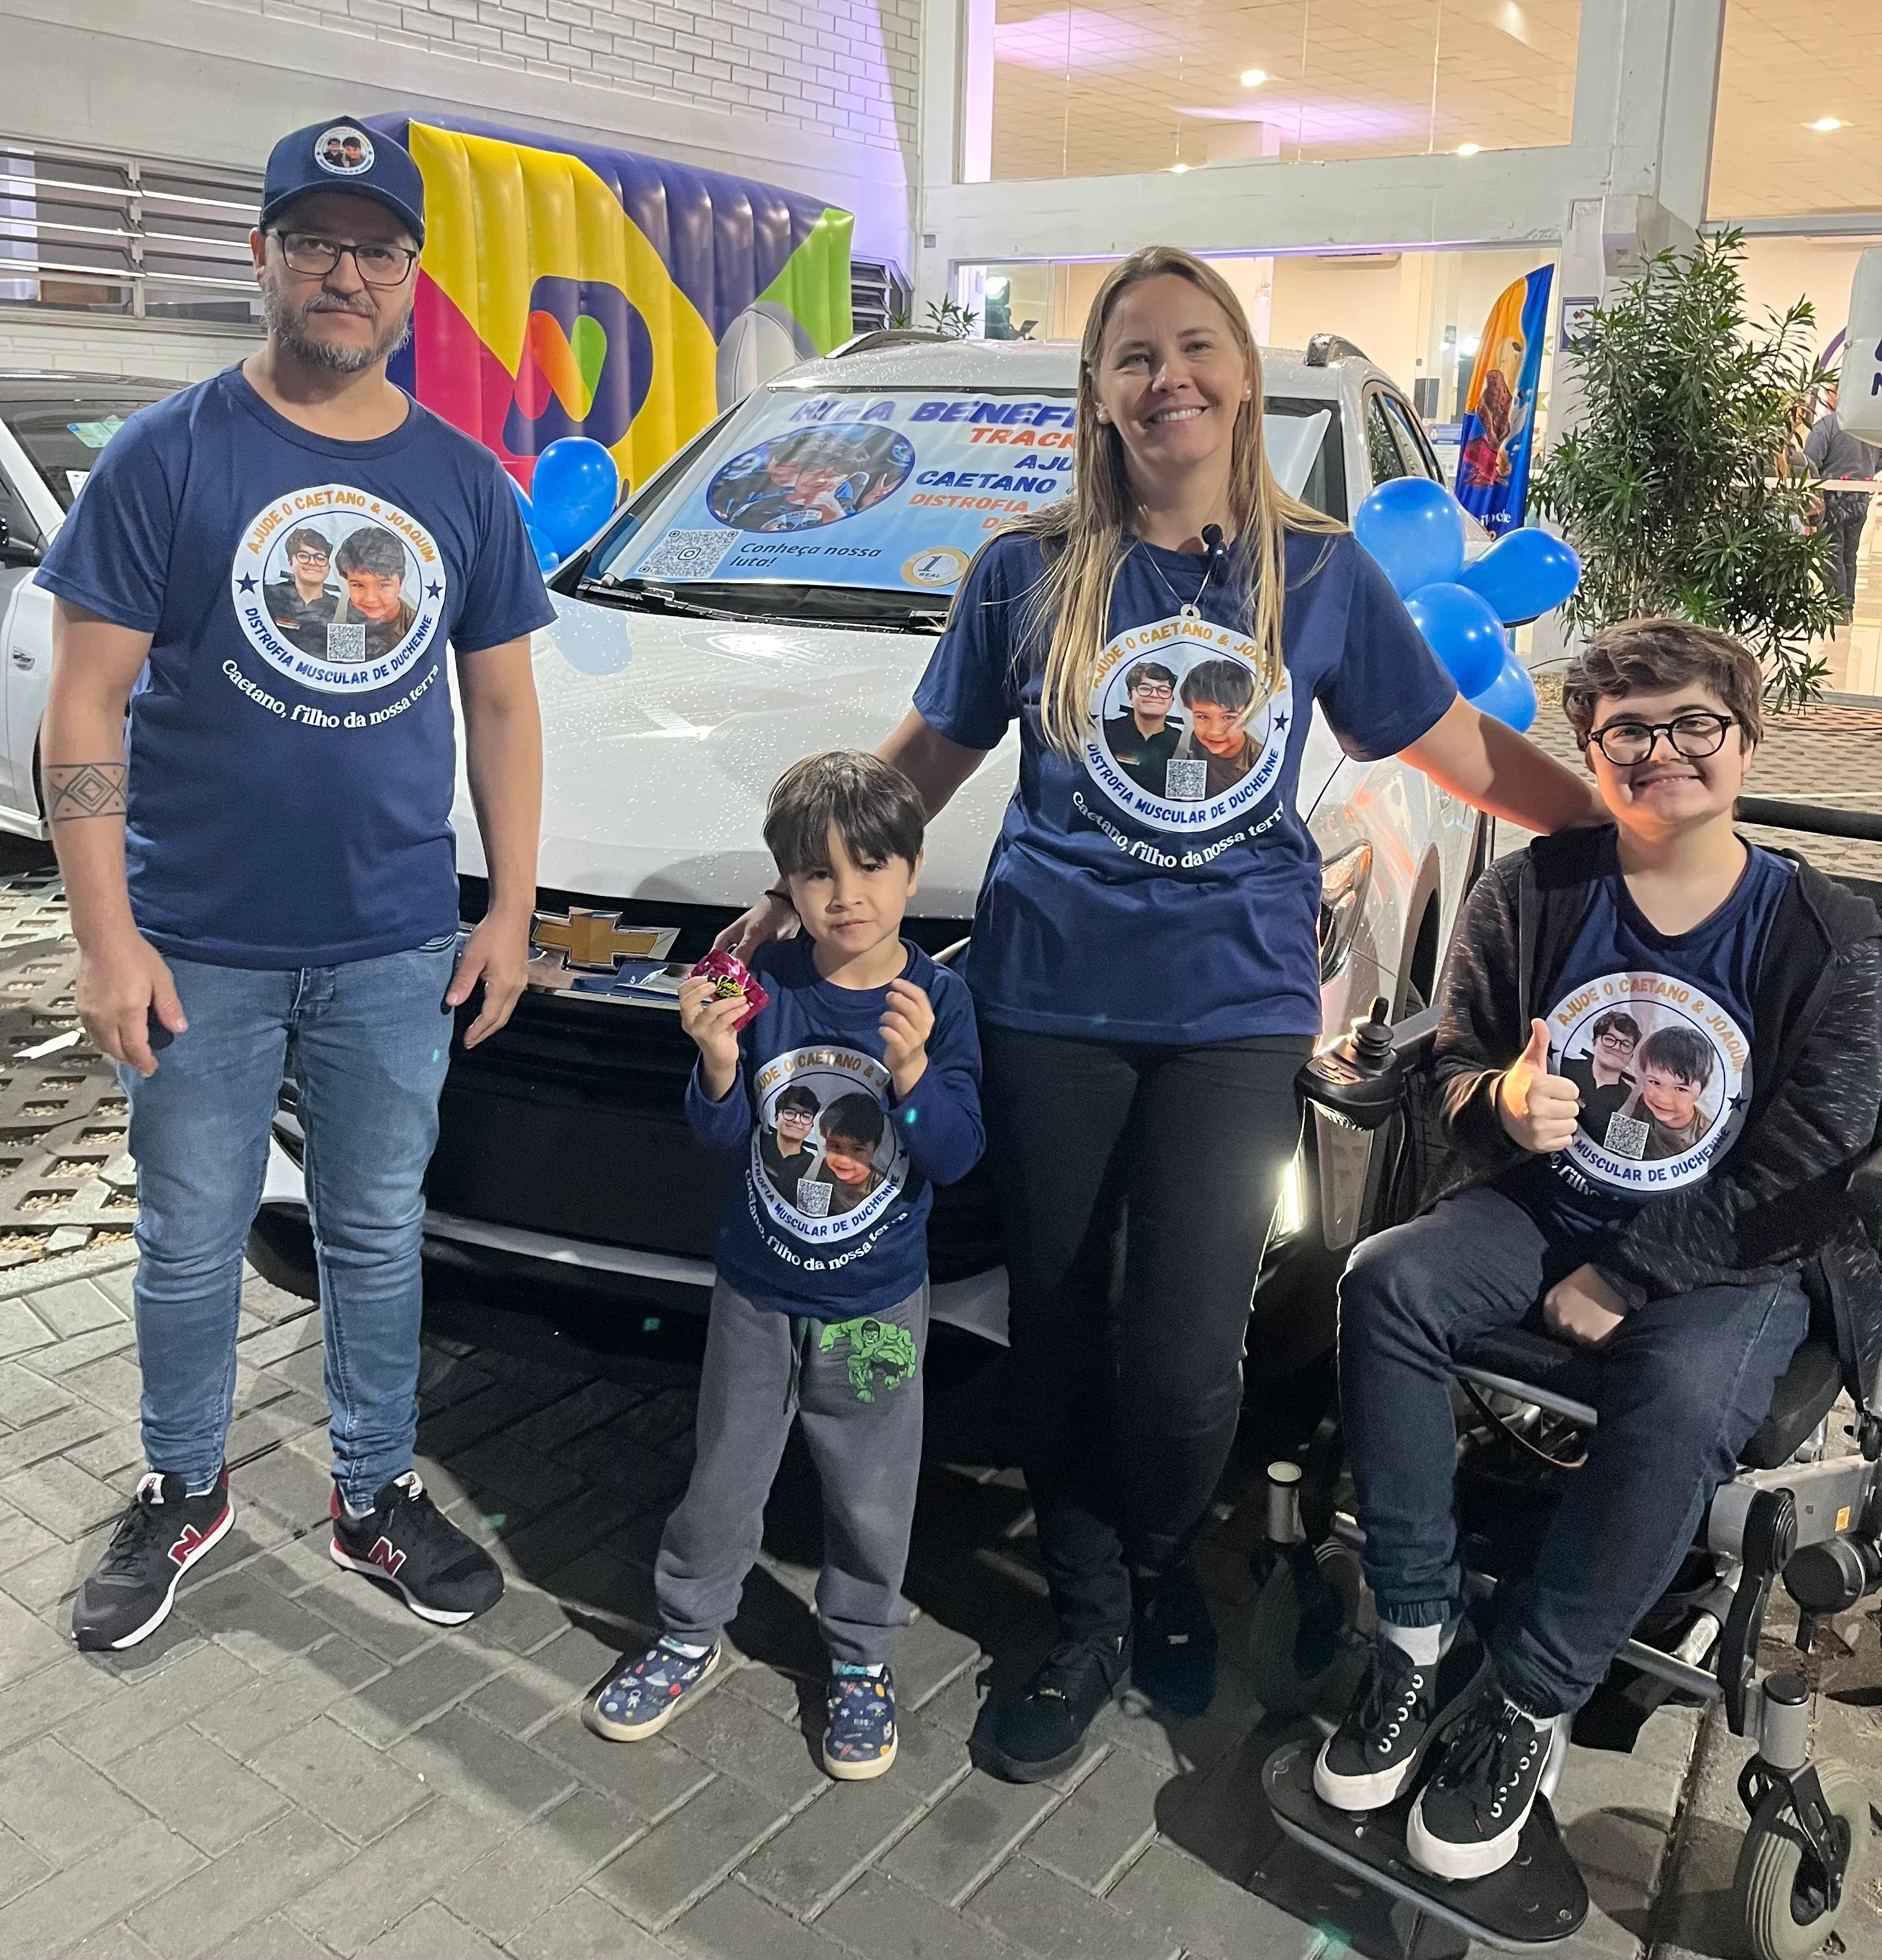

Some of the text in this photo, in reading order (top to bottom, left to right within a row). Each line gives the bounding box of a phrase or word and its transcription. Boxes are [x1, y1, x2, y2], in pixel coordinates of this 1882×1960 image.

[789, 400, 896, 422] RIFA
[1014, 454, 1073, 471] AJU
[916, 471, 1057, 494] CAETANO
[907, 492, 1029, 513] DISTROFIA
[247, 490, 437, 563] AJUDE O CAETANO & JOAQUIM
[729, 556, 777, 567] luta!
[741, 543, 882, 558] Conheça nossa
[918, 555, 942, 572] 1
[245, 607, 433, 685] DISTROFIA MUSCULAR DE DUCHENNE
[1125, 637, 1136, 649] O
[1140, 622, 1213, 644] CAETANO
[1217, 634, 1229, 645] &
[222, 659, 439, 728] Caetano, filho da nossa terra
[1087, 744, 1279, 823] DISTROFIA MUSCULAR DE DUCHENNE
[1072, 790, 1128, 851] Caetano,
[1129, 840, 1177, 868] filho
[1181, 853, 1204, 868] da
[1203, 832, 1245, 860] nossa
[1557, 987, 1599, 1026] AJUDE
[1604, 982, 1614, 996] O
[1619, 978, 1690, 1004] CAETANO
[1691, 1000, 1705, 1014] &
[757, 1066, 781, 1090] UDE
[784, 1059, 794, 1072] O
[797, 1052, 861, 1071] CAETANO
[1574, 1126, 1730, 1182] MUSCULAR DE DUCHENNE
[774, 1203, 827, 1236] MUSCULAR
[833, 1221, 848, 1234] DE
[851, 1175, 900, 1226] DUCHENNE
[766, 1236, 801, 1266] filho
[803, 1257, 825, 1270] da
[828, 1240, 872, 1270] nossa
